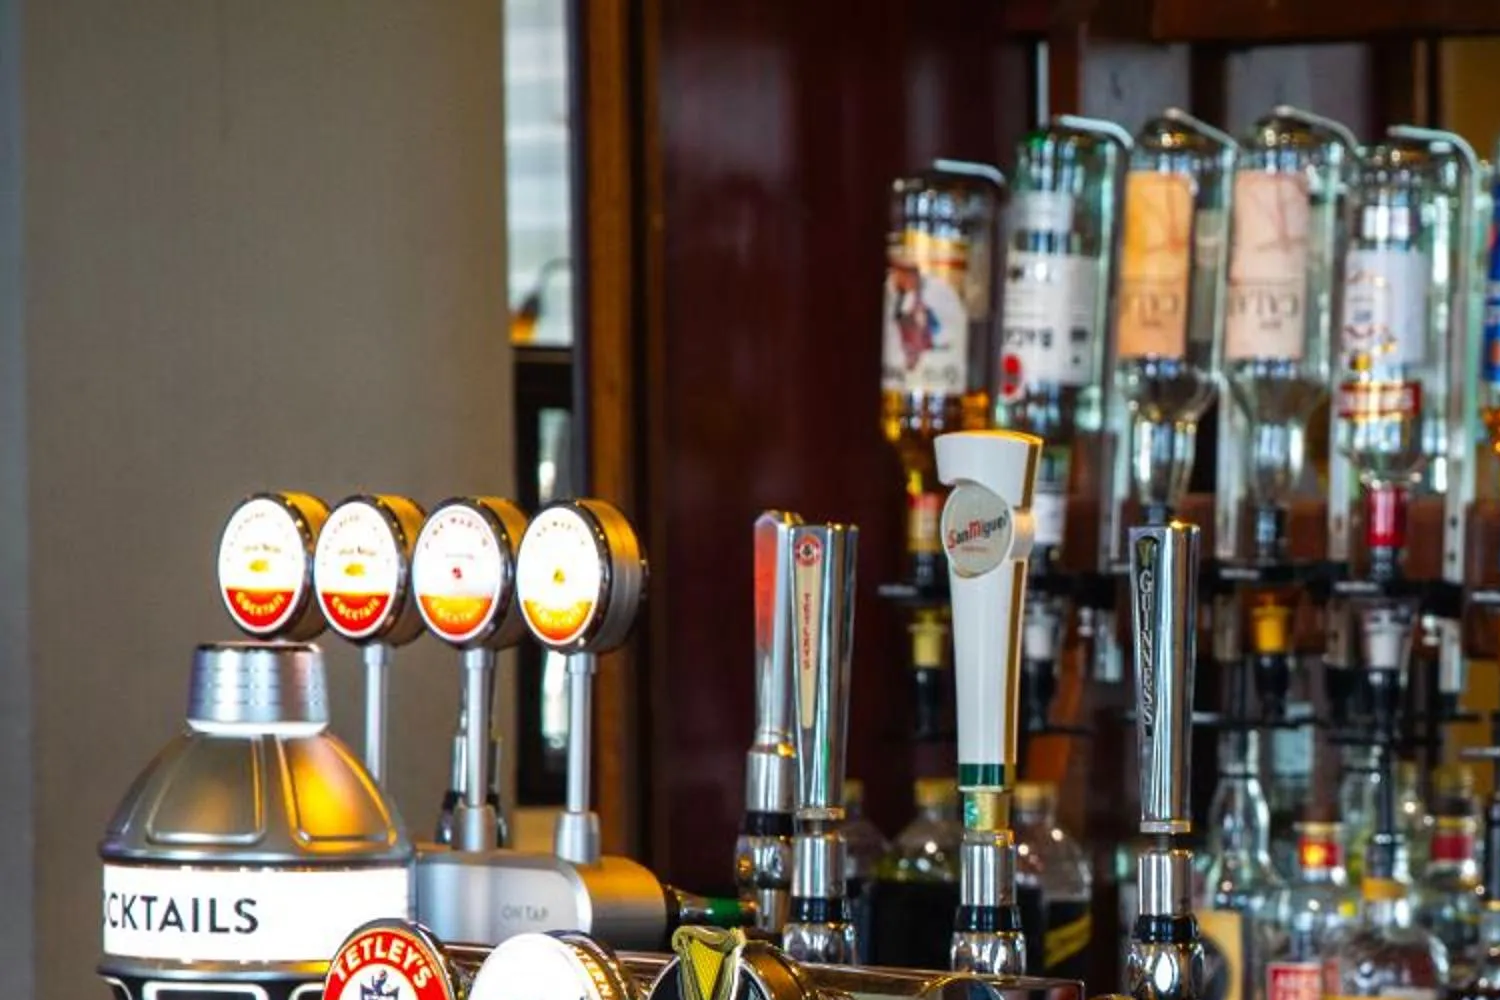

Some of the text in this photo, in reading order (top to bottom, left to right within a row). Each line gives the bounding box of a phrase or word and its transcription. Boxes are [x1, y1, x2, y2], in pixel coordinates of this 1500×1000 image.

[1137, 570, 1155, 726] GUINNESS
[103, 891, 259, 933] CKTAILS
[333, 935, 432, 989] TETLEY'S
